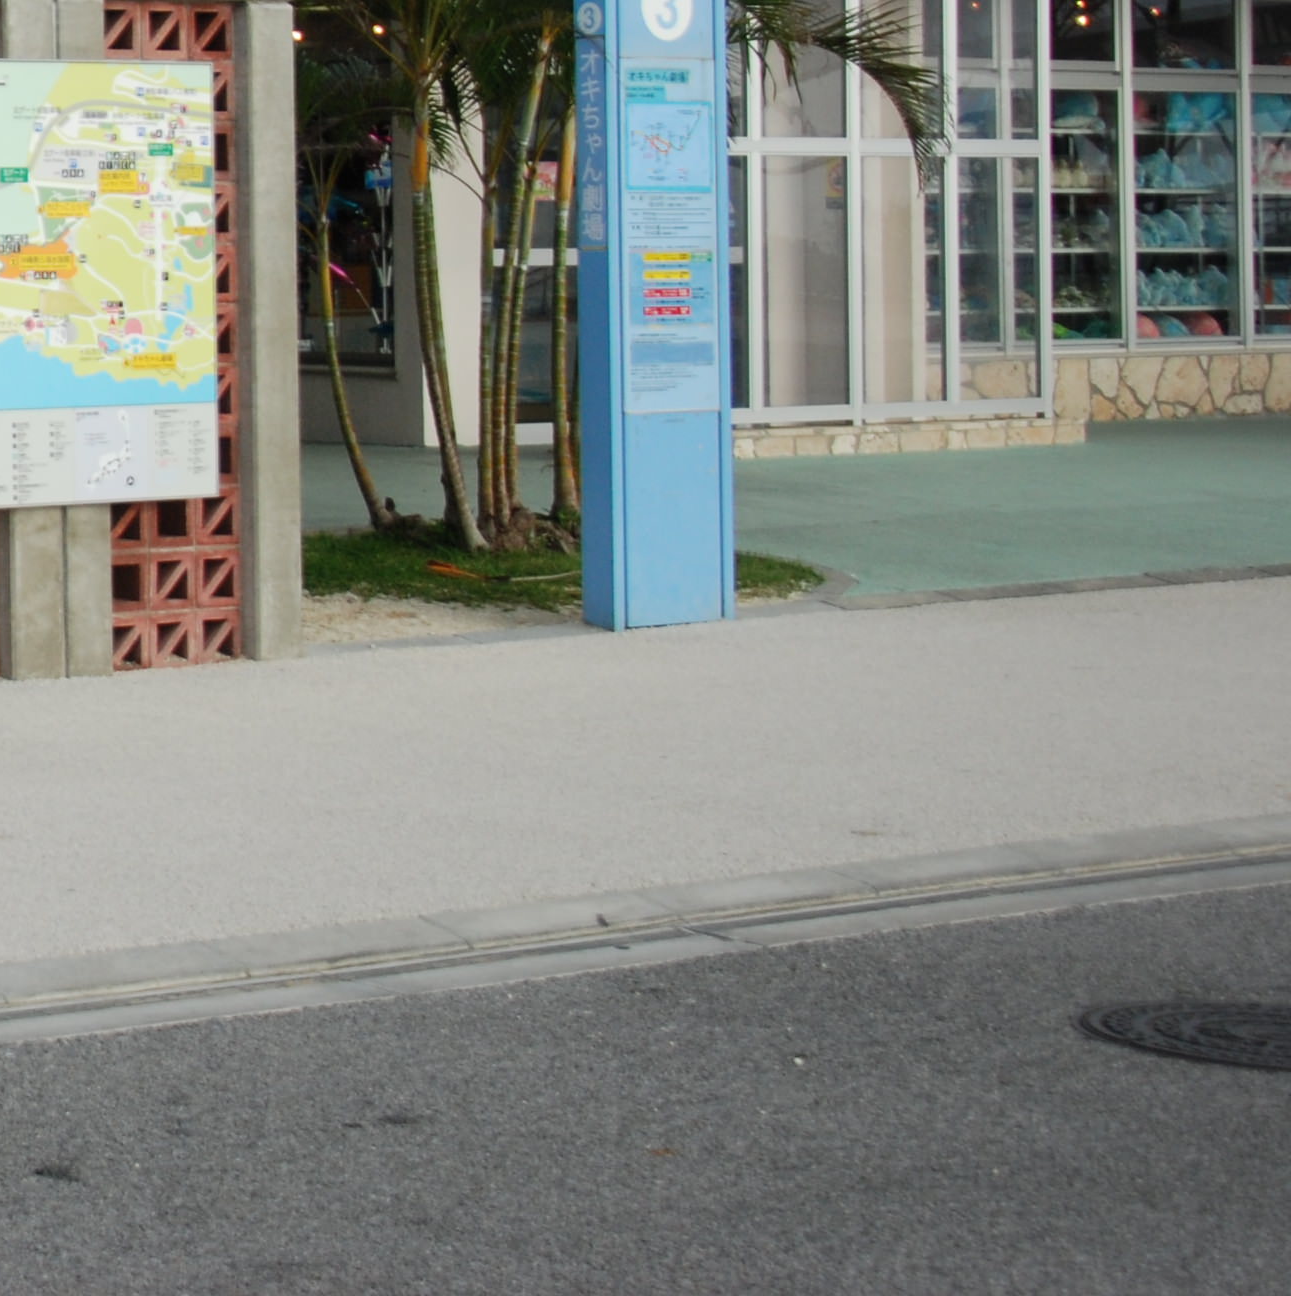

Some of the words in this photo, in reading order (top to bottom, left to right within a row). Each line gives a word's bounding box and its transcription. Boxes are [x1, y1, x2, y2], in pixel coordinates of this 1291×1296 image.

[583, 7, 594, 30] 3
[580, 50, 605, 241] オキちゃん劇場
